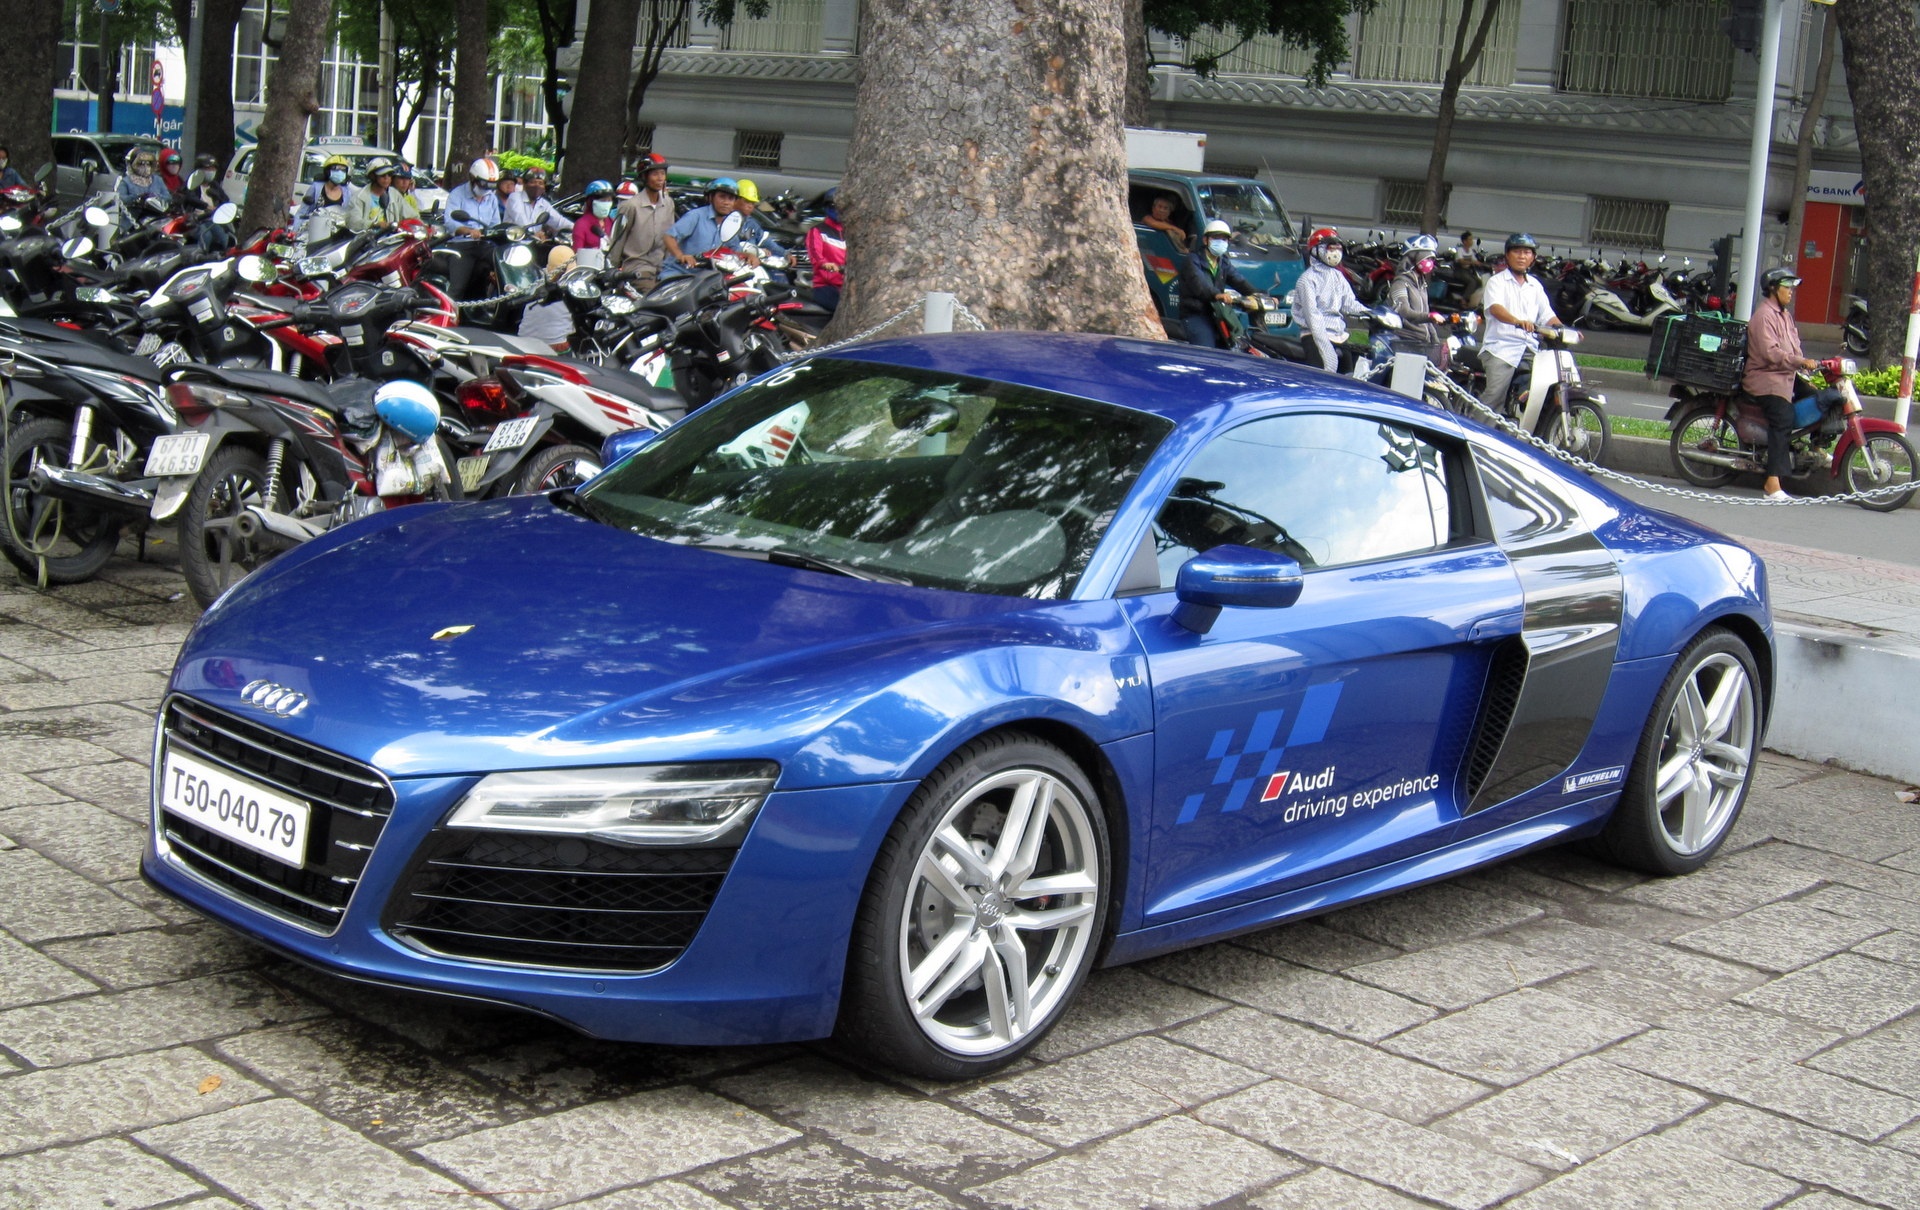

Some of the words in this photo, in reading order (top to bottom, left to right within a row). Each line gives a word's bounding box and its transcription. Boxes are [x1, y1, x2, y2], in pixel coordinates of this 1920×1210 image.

[1807, 186, 1820, 194] PG
[1822, 188, 1851, 196] BANK
[149, 455, 199, 474] 246.59
[1287, 765, 1336, 795] Audi
[1577, 769, 1621, 786] MICHELIN
[172, 766, 297, 848] T50-040.79
[1283, 795, 1348, 823] driving
[1352, 773, 1439, 809] experience
